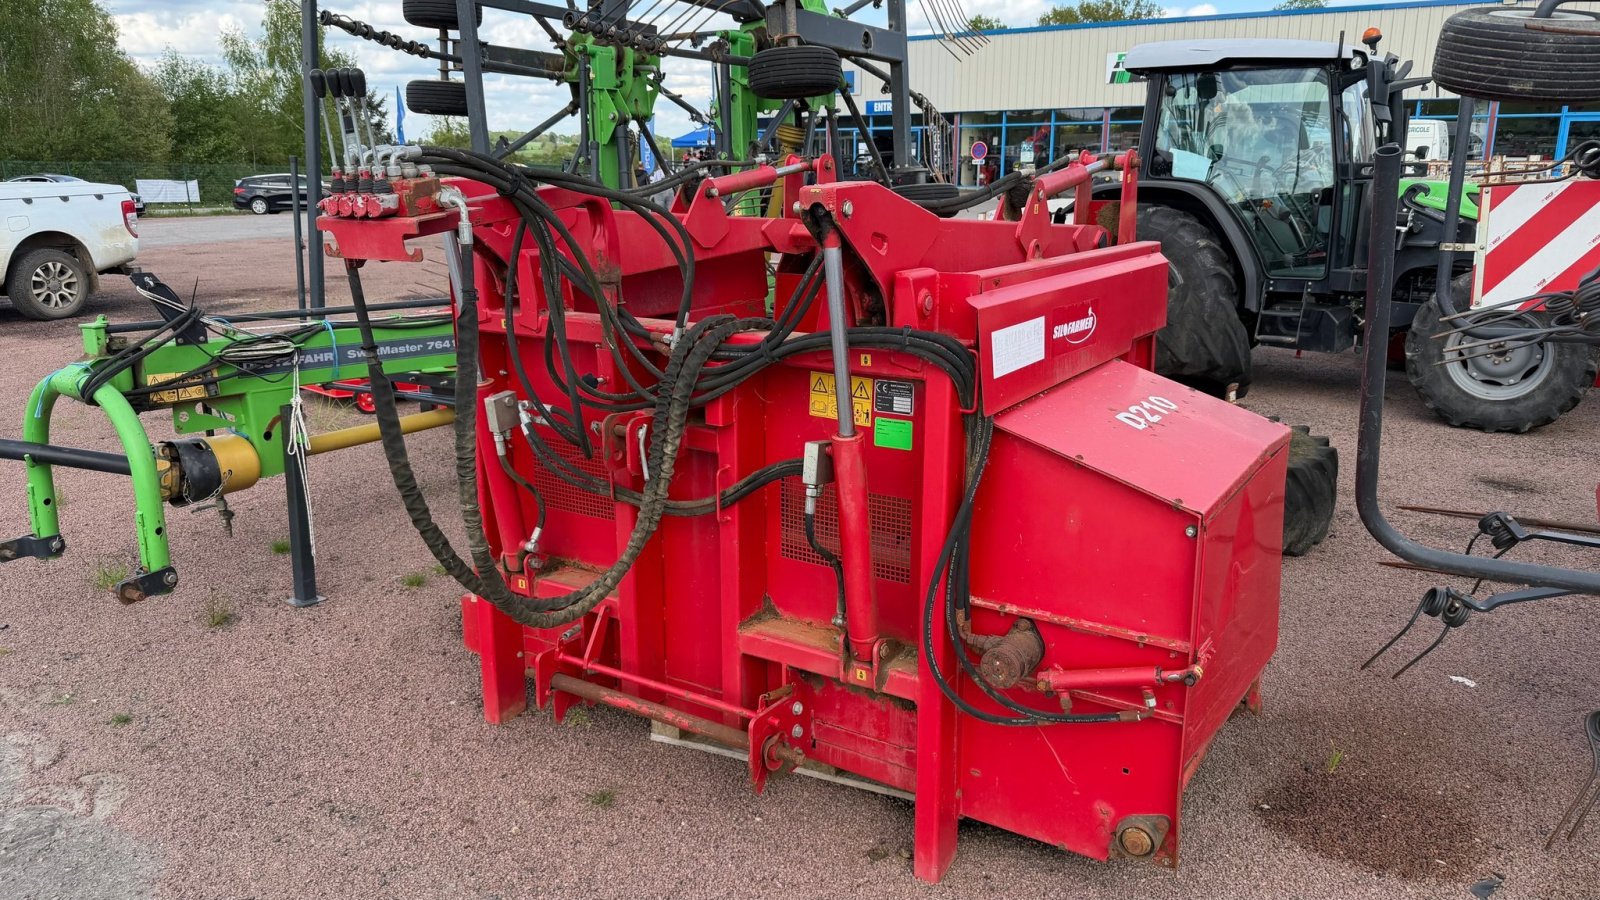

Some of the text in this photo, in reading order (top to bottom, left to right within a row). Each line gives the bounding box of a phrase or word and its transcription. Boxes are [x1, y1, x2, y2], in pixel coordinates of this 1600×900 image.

[874, 101, 893, 112] ENTR
[1052, 316, 1094, 339] SILOFARMER
[347, 343, 424, 359] SwtMaster
[1115, 396, 1178, 430] D210
